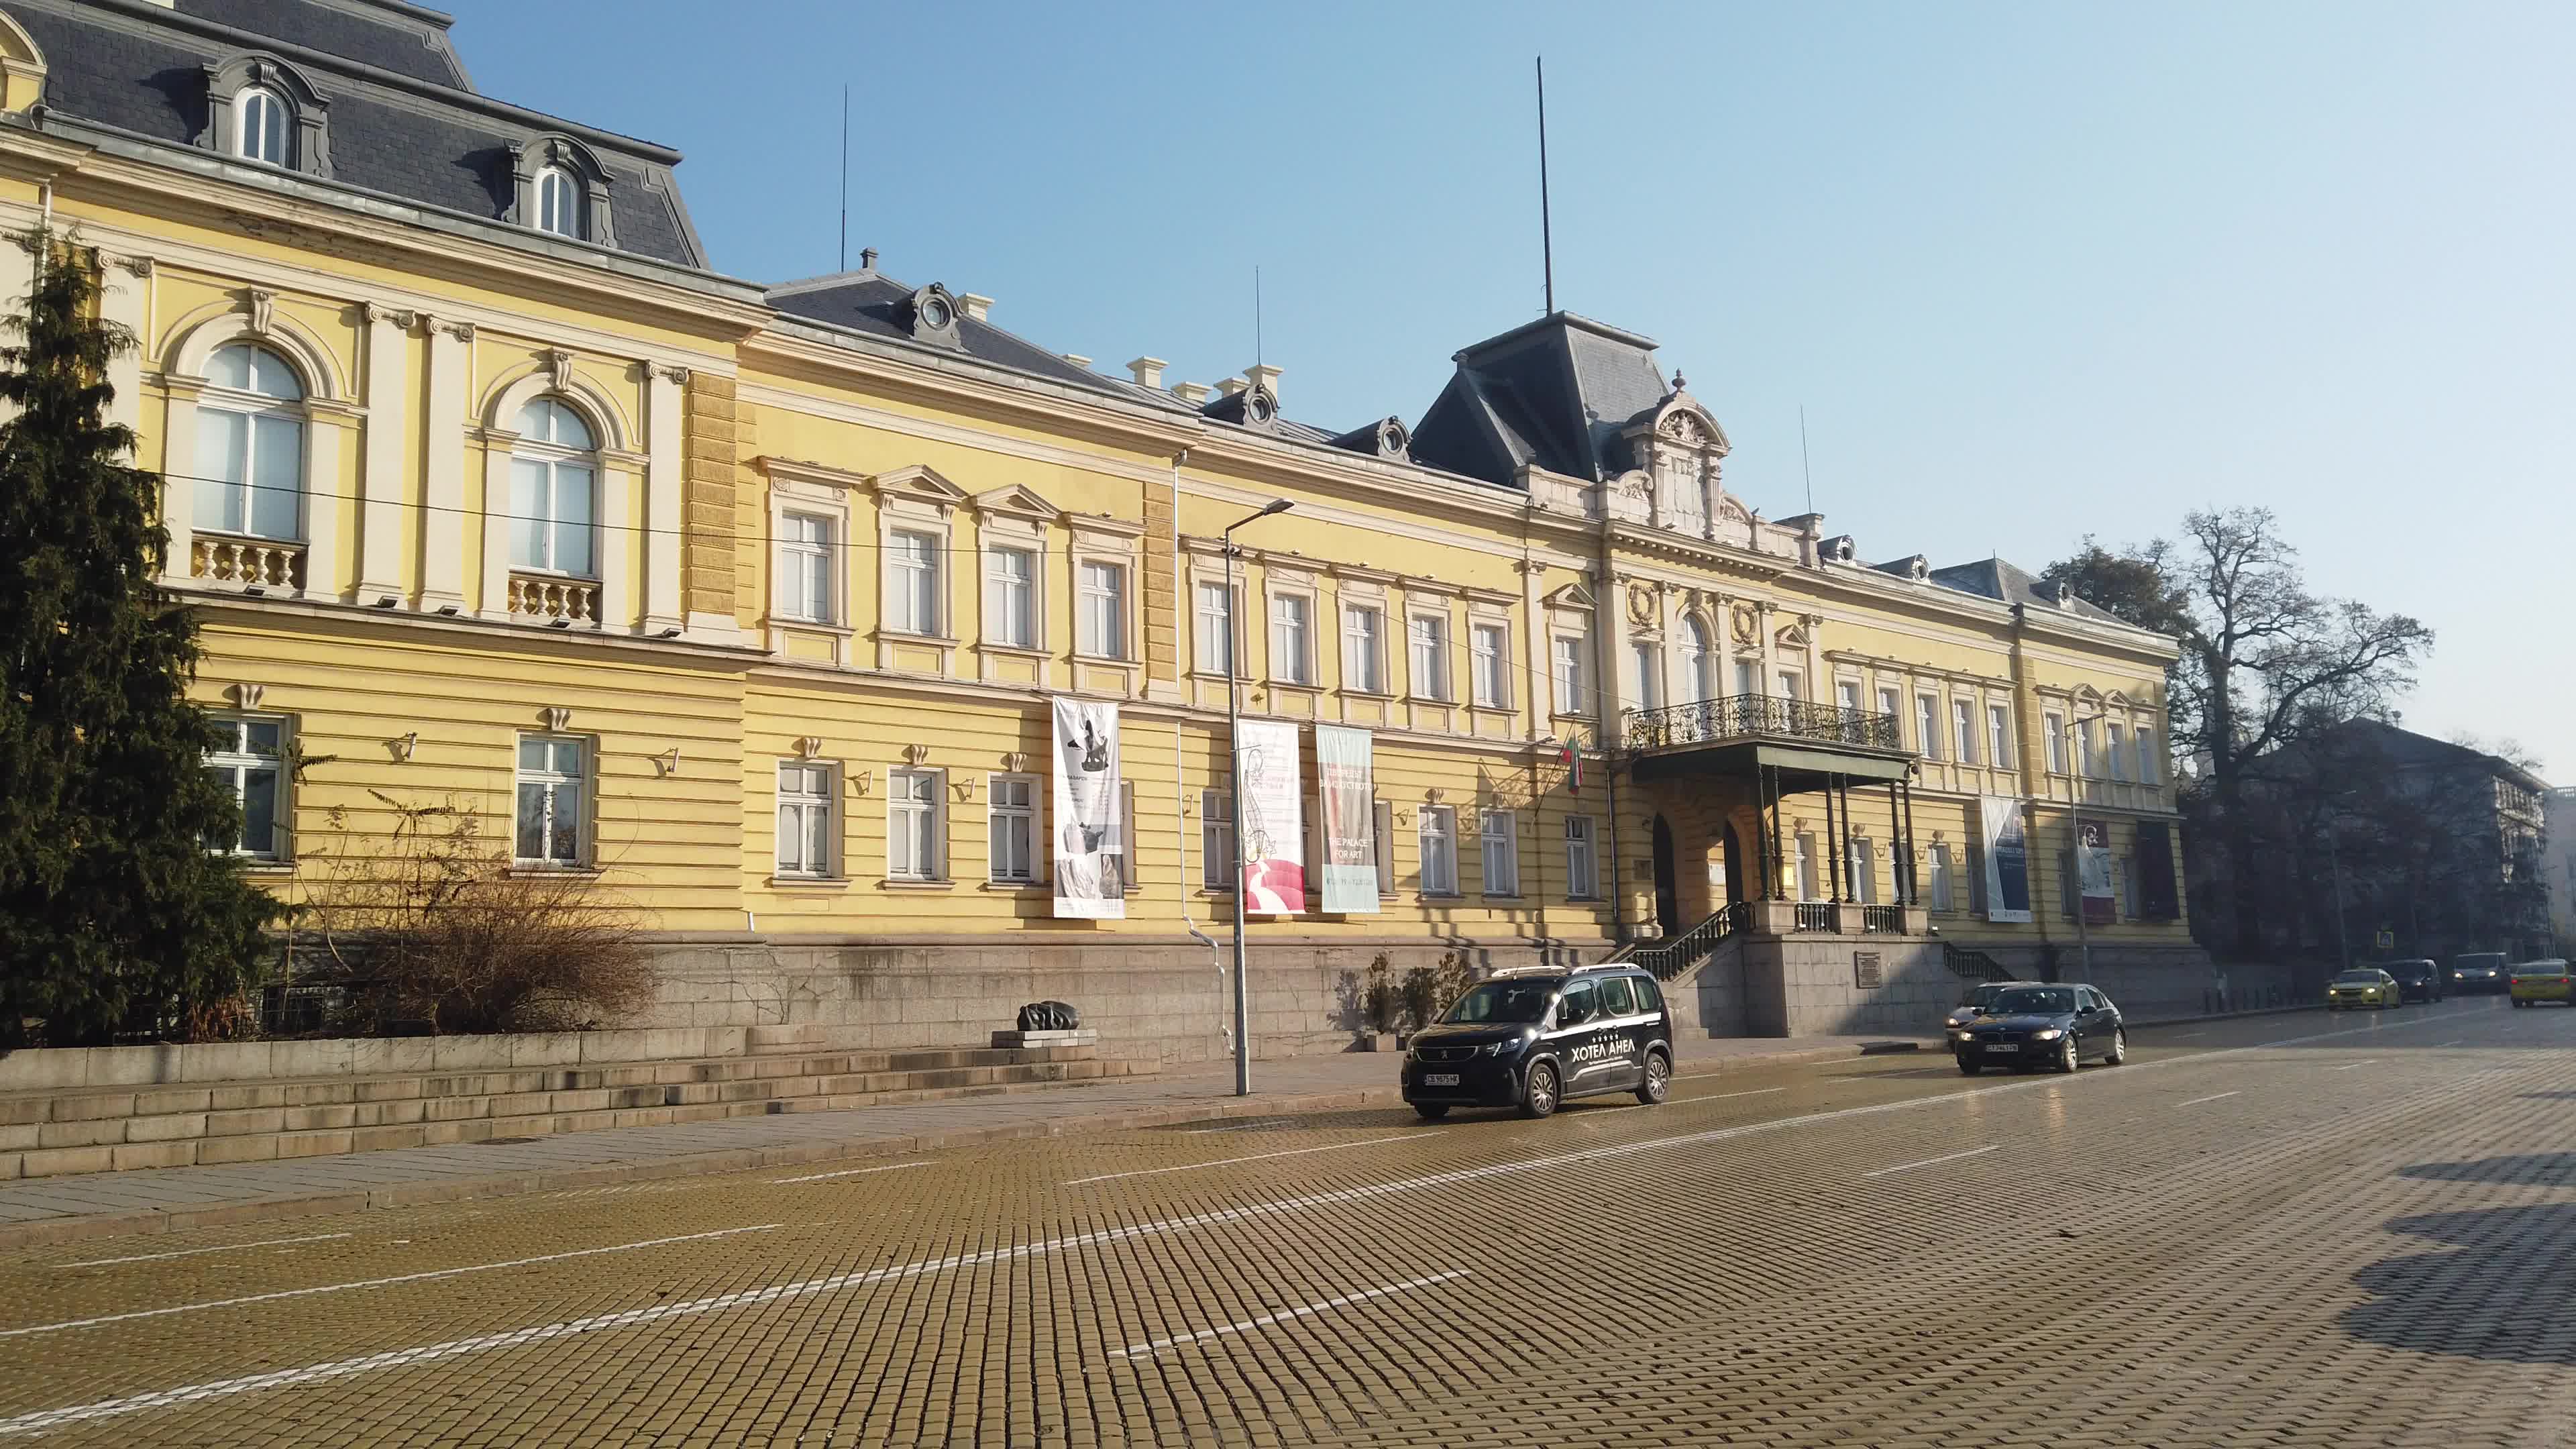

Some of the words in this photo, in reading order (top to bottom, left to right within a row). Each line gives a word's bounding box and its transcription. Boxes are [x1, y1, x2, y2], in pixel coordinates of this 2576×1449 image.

[1328, 837, 1342, 846] THE
[1342, 838, 1368, 847] PALACE
[1336, 850, 1348, 859] FOR
[1349, 851, 1362, 859] ART
[1571, 1043, 1607, 1063] ХОТЕЛ
[1609, 1038, 1635, 1056] АНЕЛ
